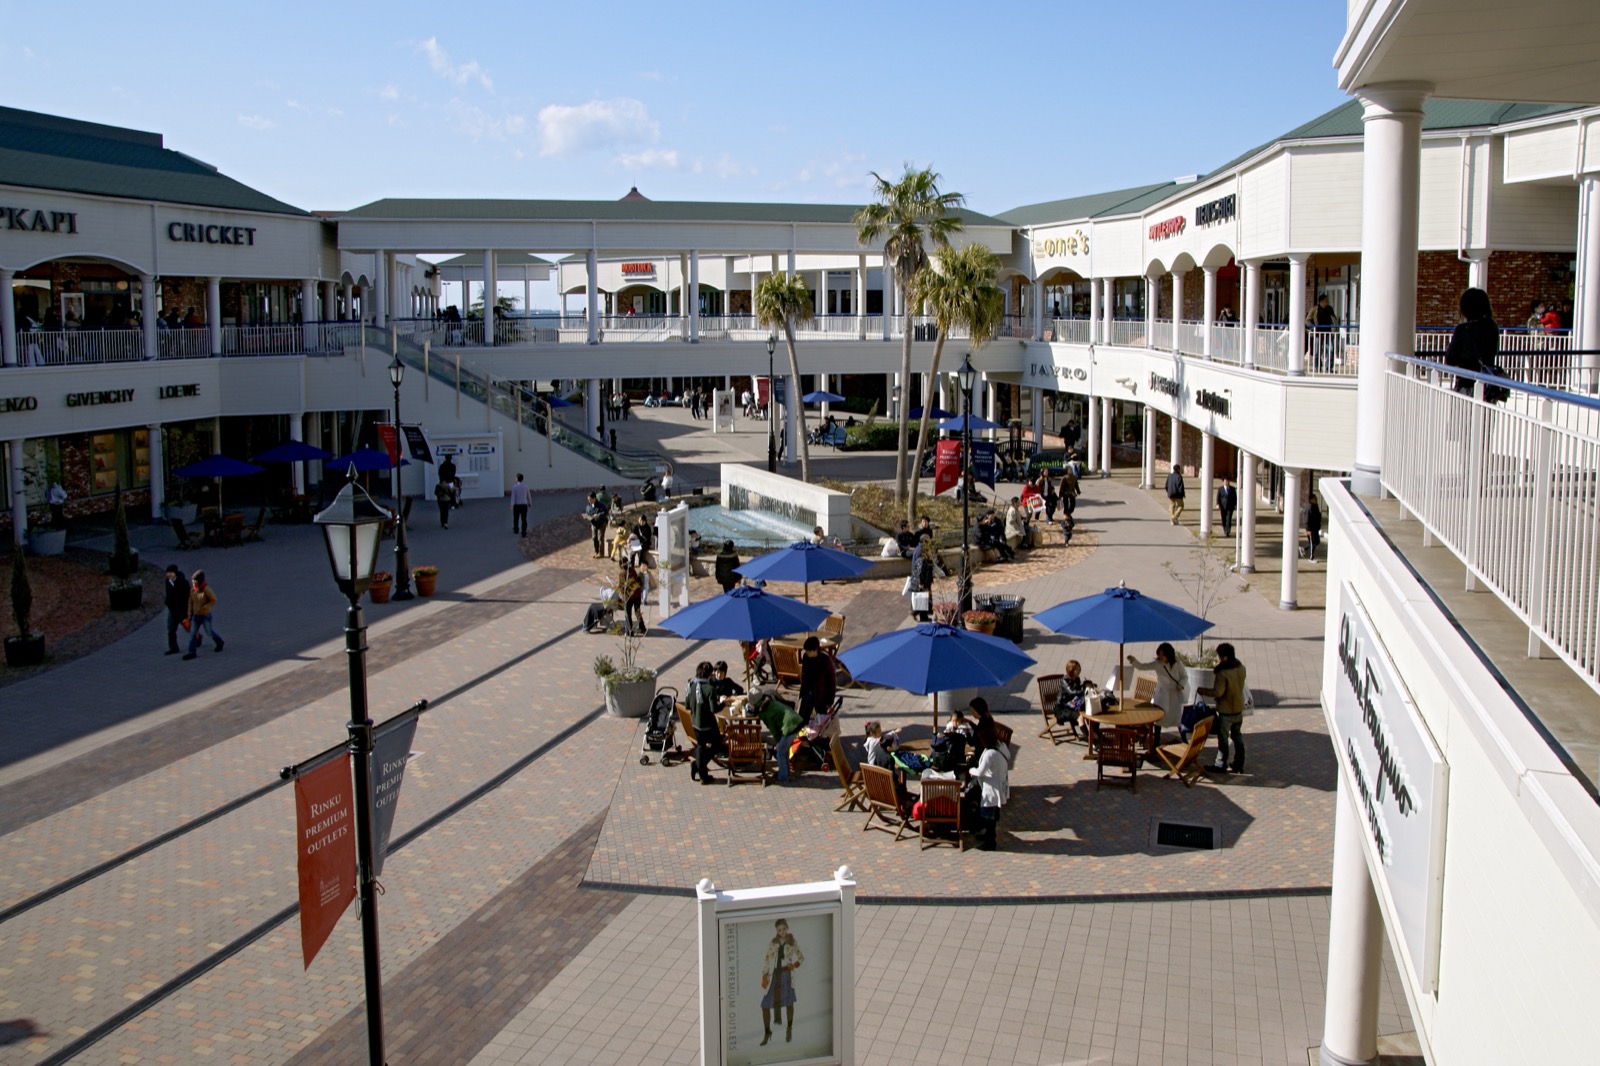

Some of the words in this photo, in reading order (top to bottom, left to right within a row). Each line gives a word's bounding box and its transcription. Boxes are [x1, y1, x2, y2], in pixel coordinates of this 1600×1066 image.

[168, 222, 256, 246] CRICKET
[1030, 362, 1087, 380] JAYRO
[66, 388, 135, 407] GIVENCHY
[159, 383, 201, 399] LOEWE
[305, 807, 348, 839] PREMIUM
[1368, 798, 1386, 865] STORE
[307, 824, 348, 855] OUTLETS
[728, 966, 736, 1008] PREMIUM
[728, 1012, 737, 1051] OUTLETS
